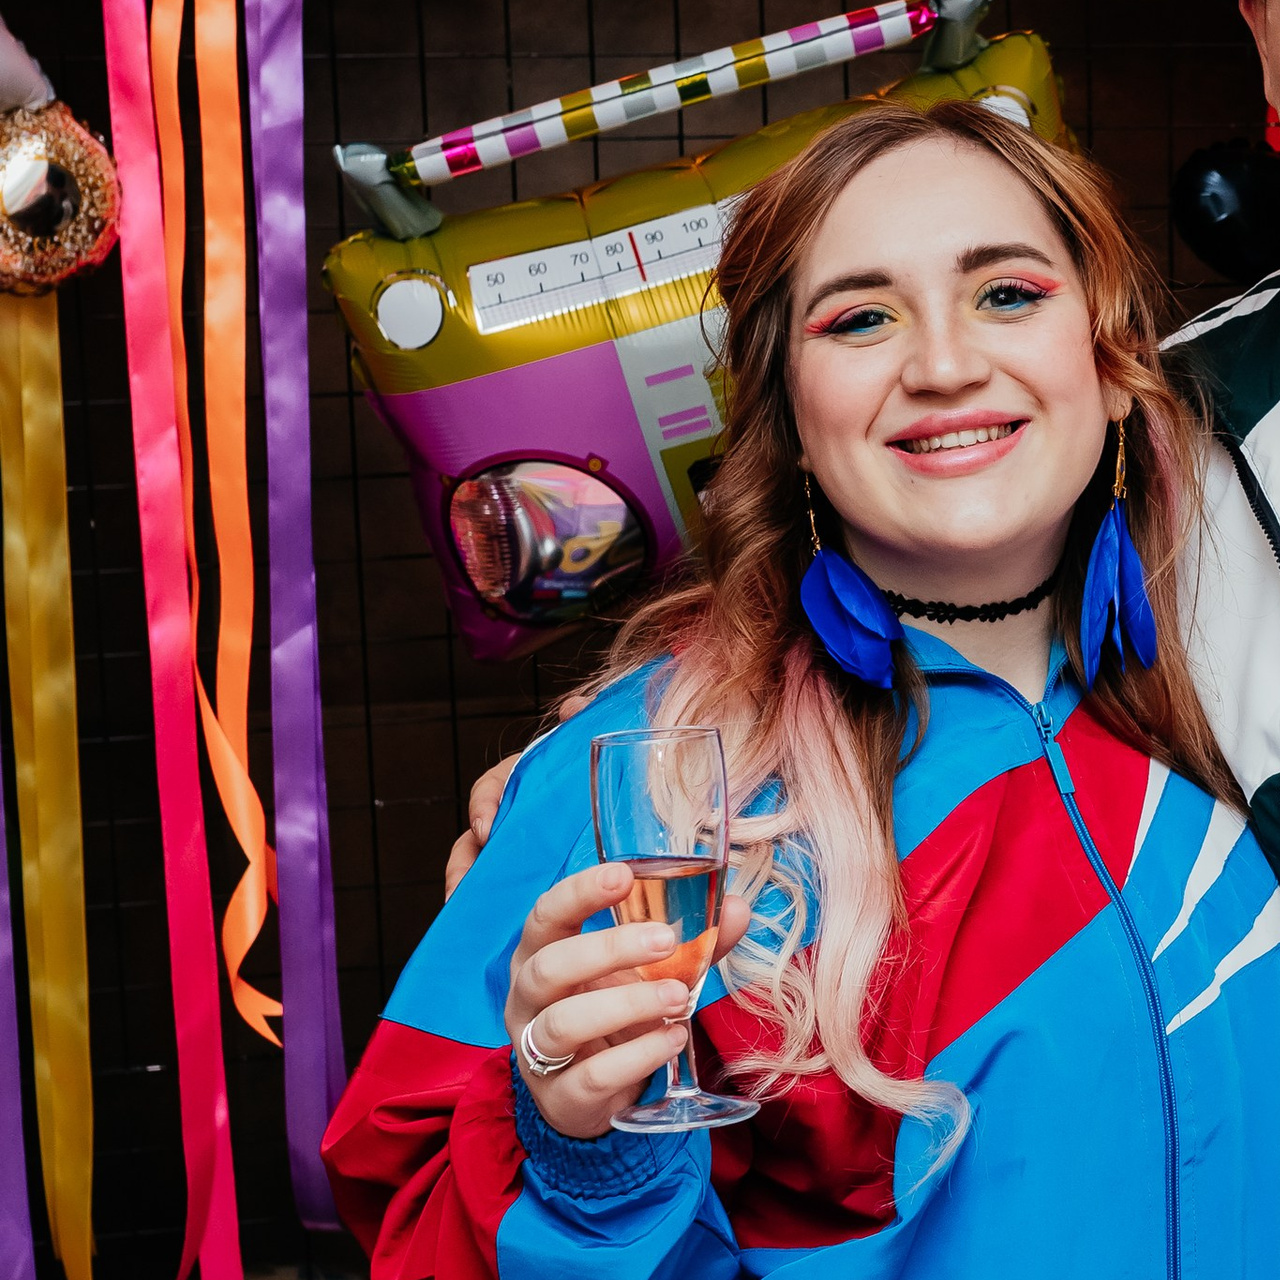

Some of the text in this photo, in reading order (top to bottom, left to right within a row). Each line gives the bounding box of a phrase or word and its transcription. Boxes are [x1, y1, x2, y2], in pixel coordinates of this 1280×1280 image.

[487, 218, 708, 287] 50 60 70 80 90 100
